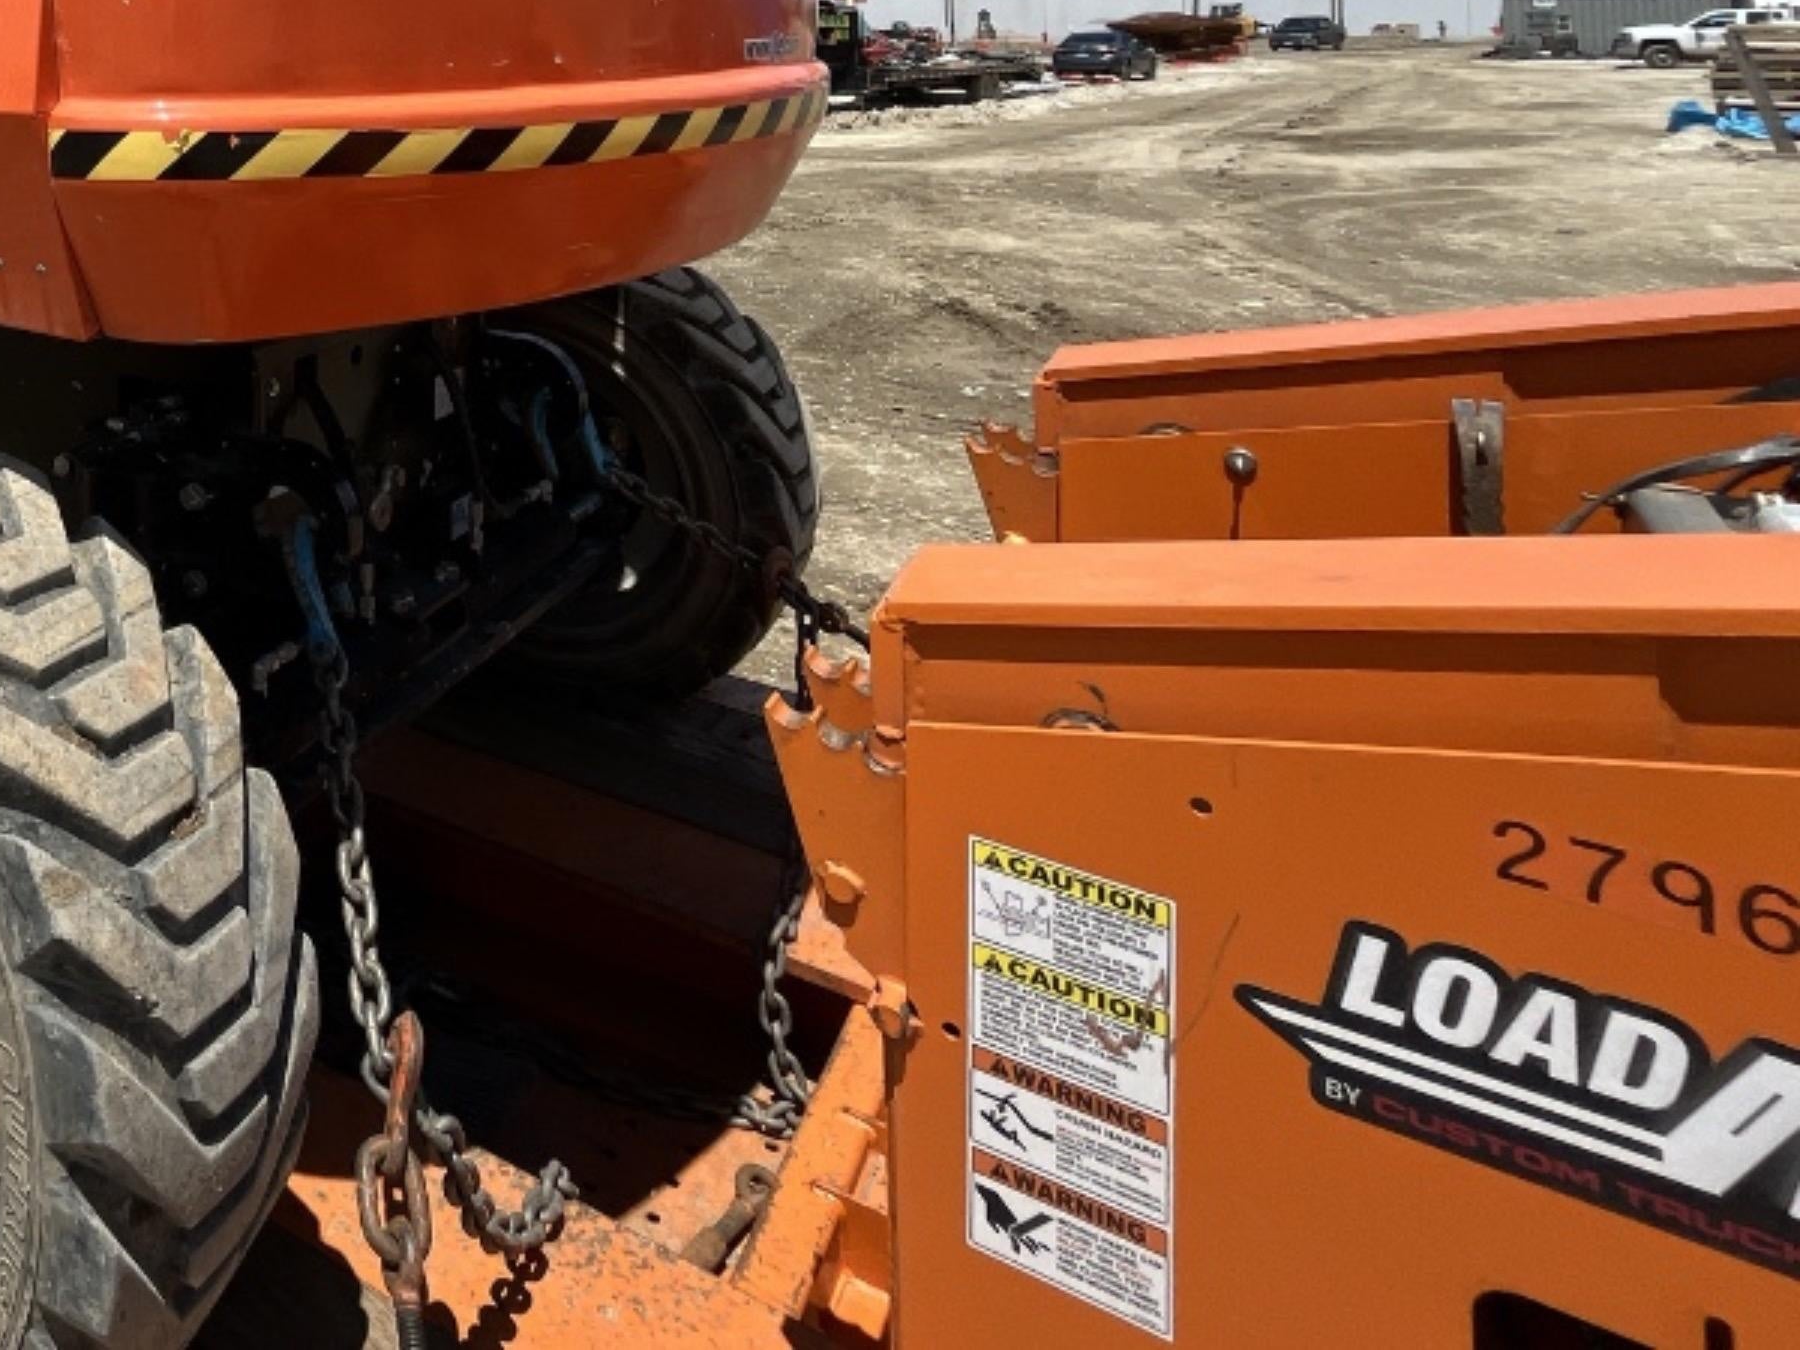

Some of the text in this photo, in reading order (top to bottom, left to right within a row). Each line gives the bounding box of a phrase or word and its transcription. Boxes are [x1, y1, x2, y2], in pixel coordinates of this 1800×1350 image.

[1007, 855, 1157, 921] CAUTION
[1492, 820, 1800, 956] 2796
[1007, 957, 1157, 1030] CAUTION
[1340, 933, 1691, 1112] LOAD
[1011, 1064, 1147, 1134] WARNING
[1324, 1076, 1363, 1107] BY
[1372, 1094, 1602, 1193] CUSTOM
[1011, 1168, 1147, 1244] WARNING
